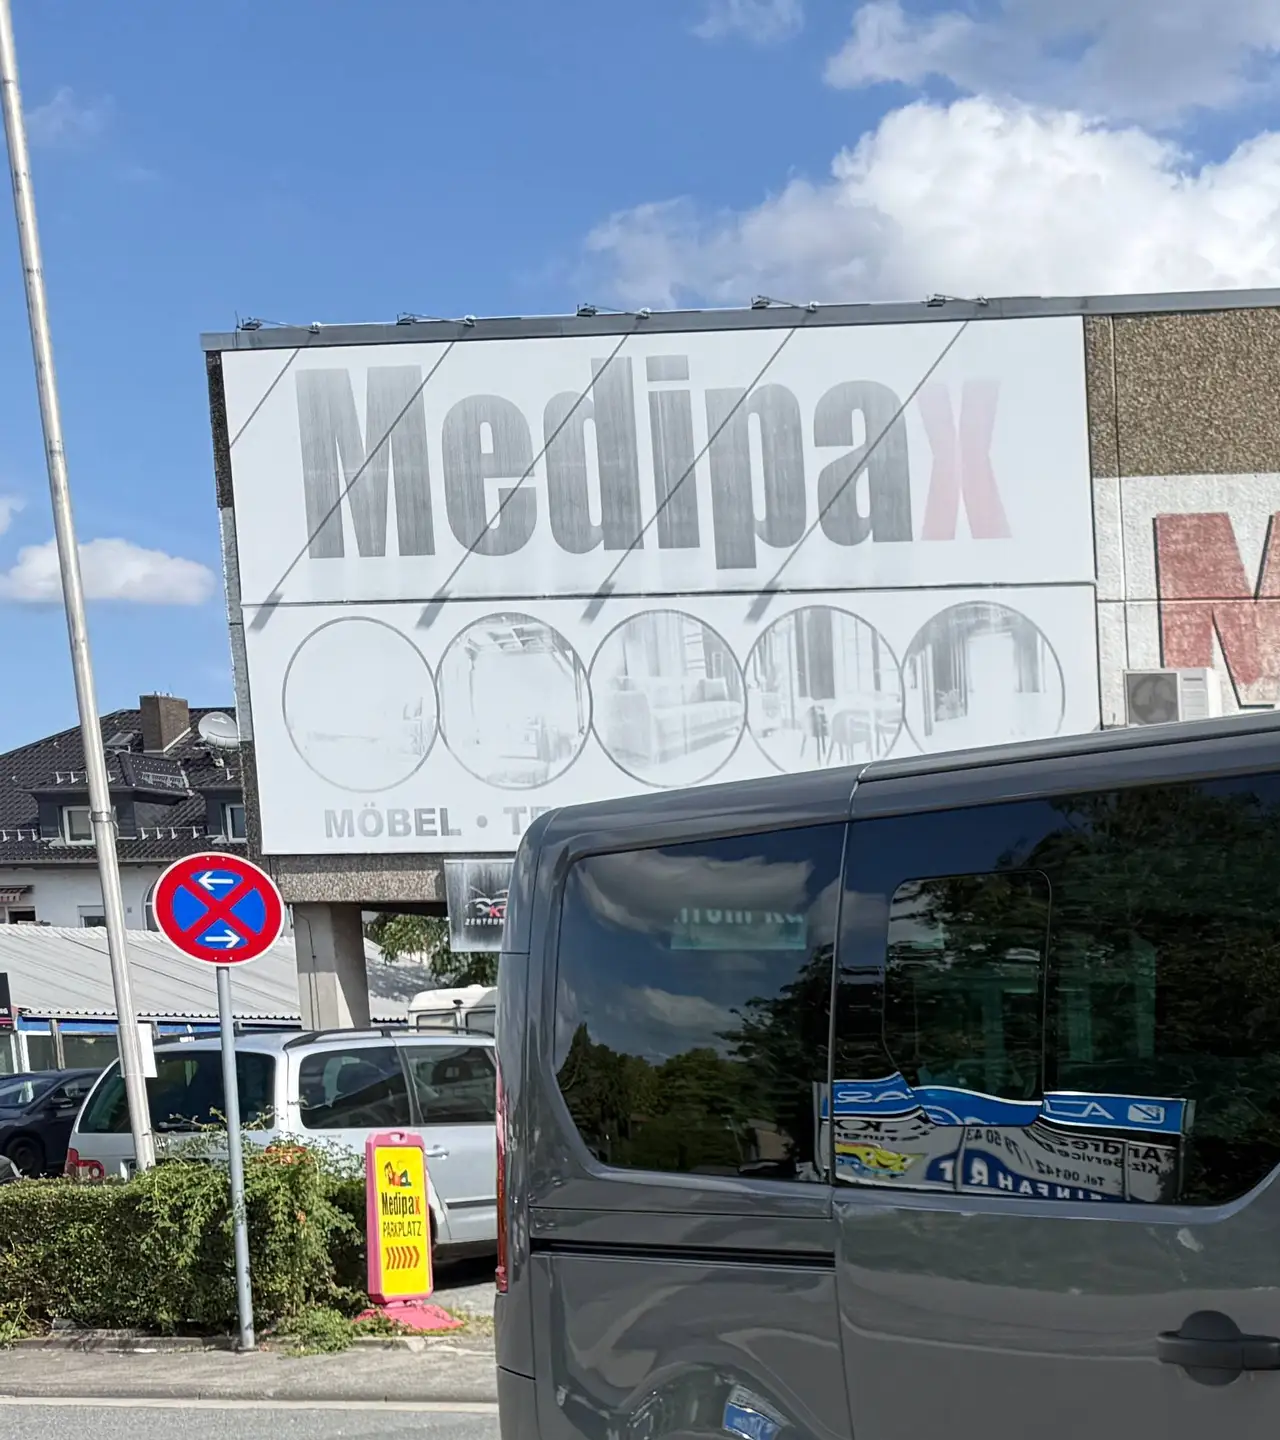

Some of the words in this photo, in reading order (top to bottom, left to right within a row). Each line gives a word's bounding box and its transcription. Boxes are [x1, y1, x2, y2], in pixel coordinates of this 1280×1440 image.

[295, 355, 1013, 569] Medipax
[324, 802, 462, 838] MÖBEL
[381, 1192, 421, 1218] Medipax
[383, 1220, 422, 1238] PARKPLATZ
